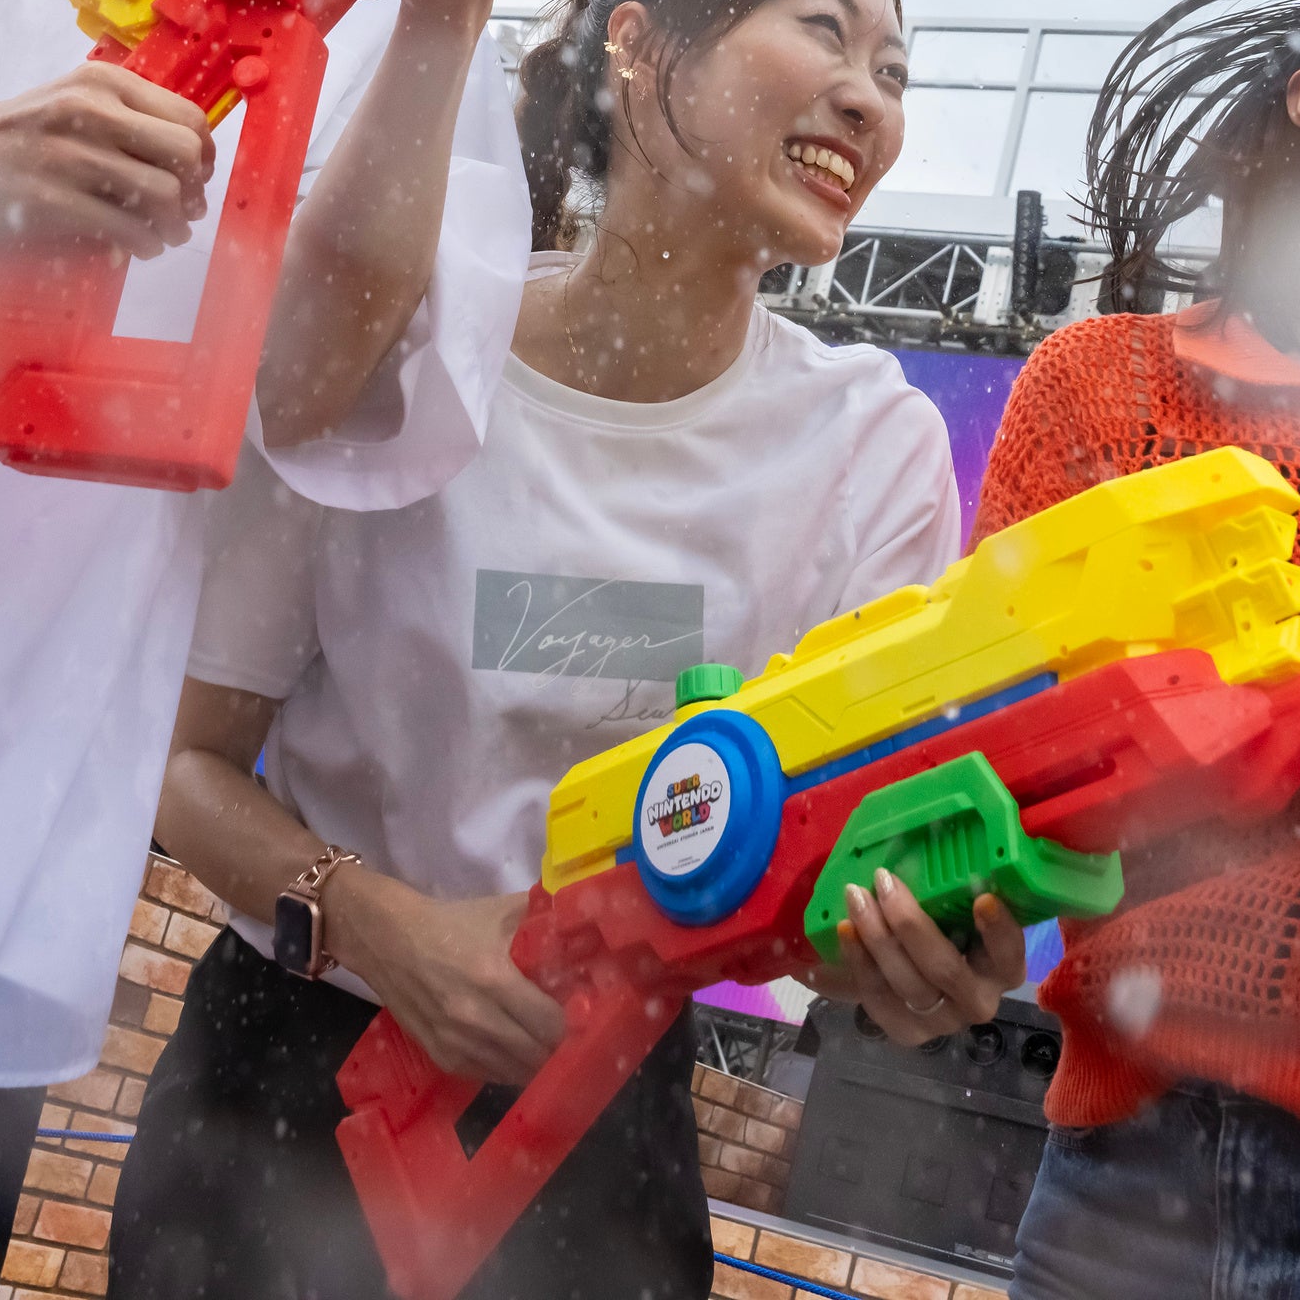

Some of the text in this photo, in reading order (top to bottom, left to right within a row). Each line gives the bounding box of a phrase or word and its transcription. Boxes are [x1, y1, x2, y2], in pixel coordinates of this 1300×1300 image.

[497, 574, 704, 695] Voyager
[647, 780, 722, 826] NINTENDO
[667, 774, 700, 799] SUPER
[658, 802, 711, 837] WORLD
